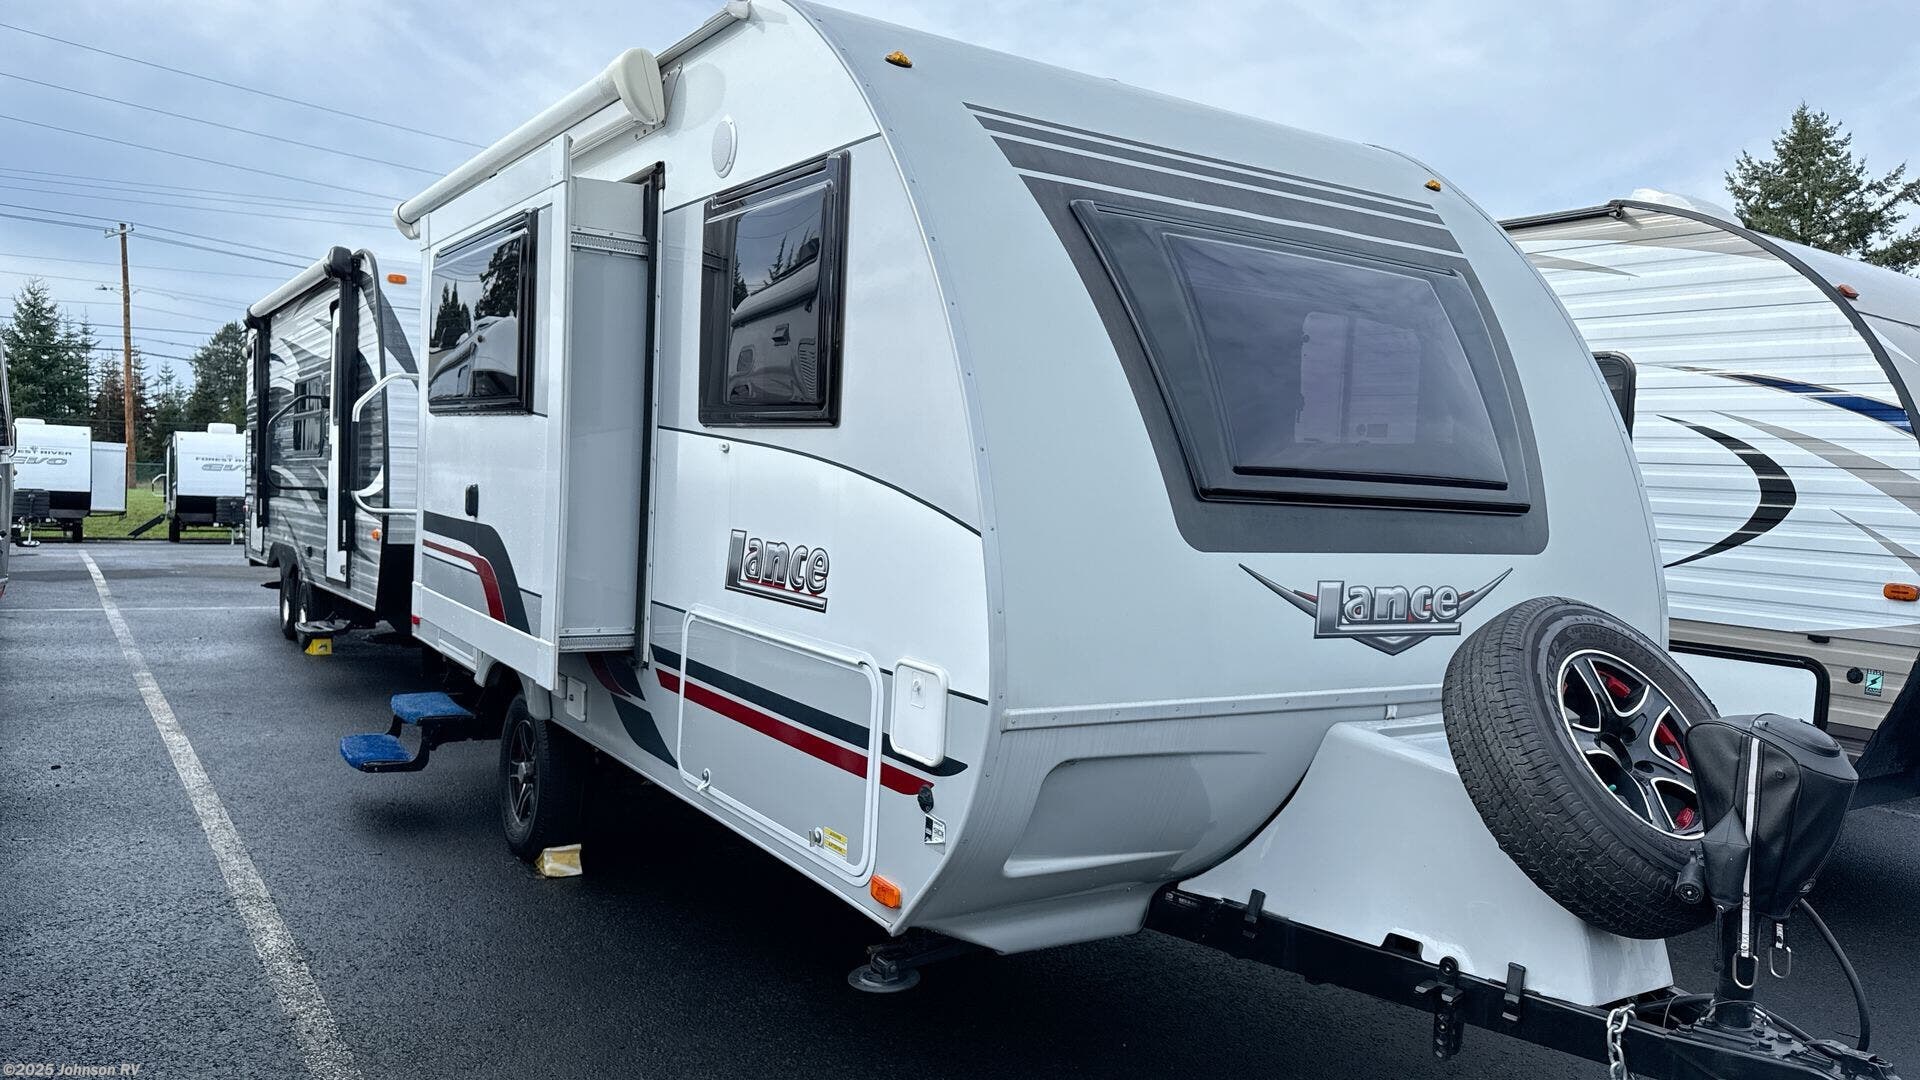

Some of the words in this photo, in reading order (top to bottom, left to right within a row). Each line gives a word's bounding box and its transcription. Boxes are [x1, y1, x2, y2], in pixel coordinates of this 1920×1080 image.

[195, 455, 232, 463] FOREST
[201, 463, 245, 471] EV
[724, 528, 830, 613] Lance
[1313, 579, 1462, 639] Lance
